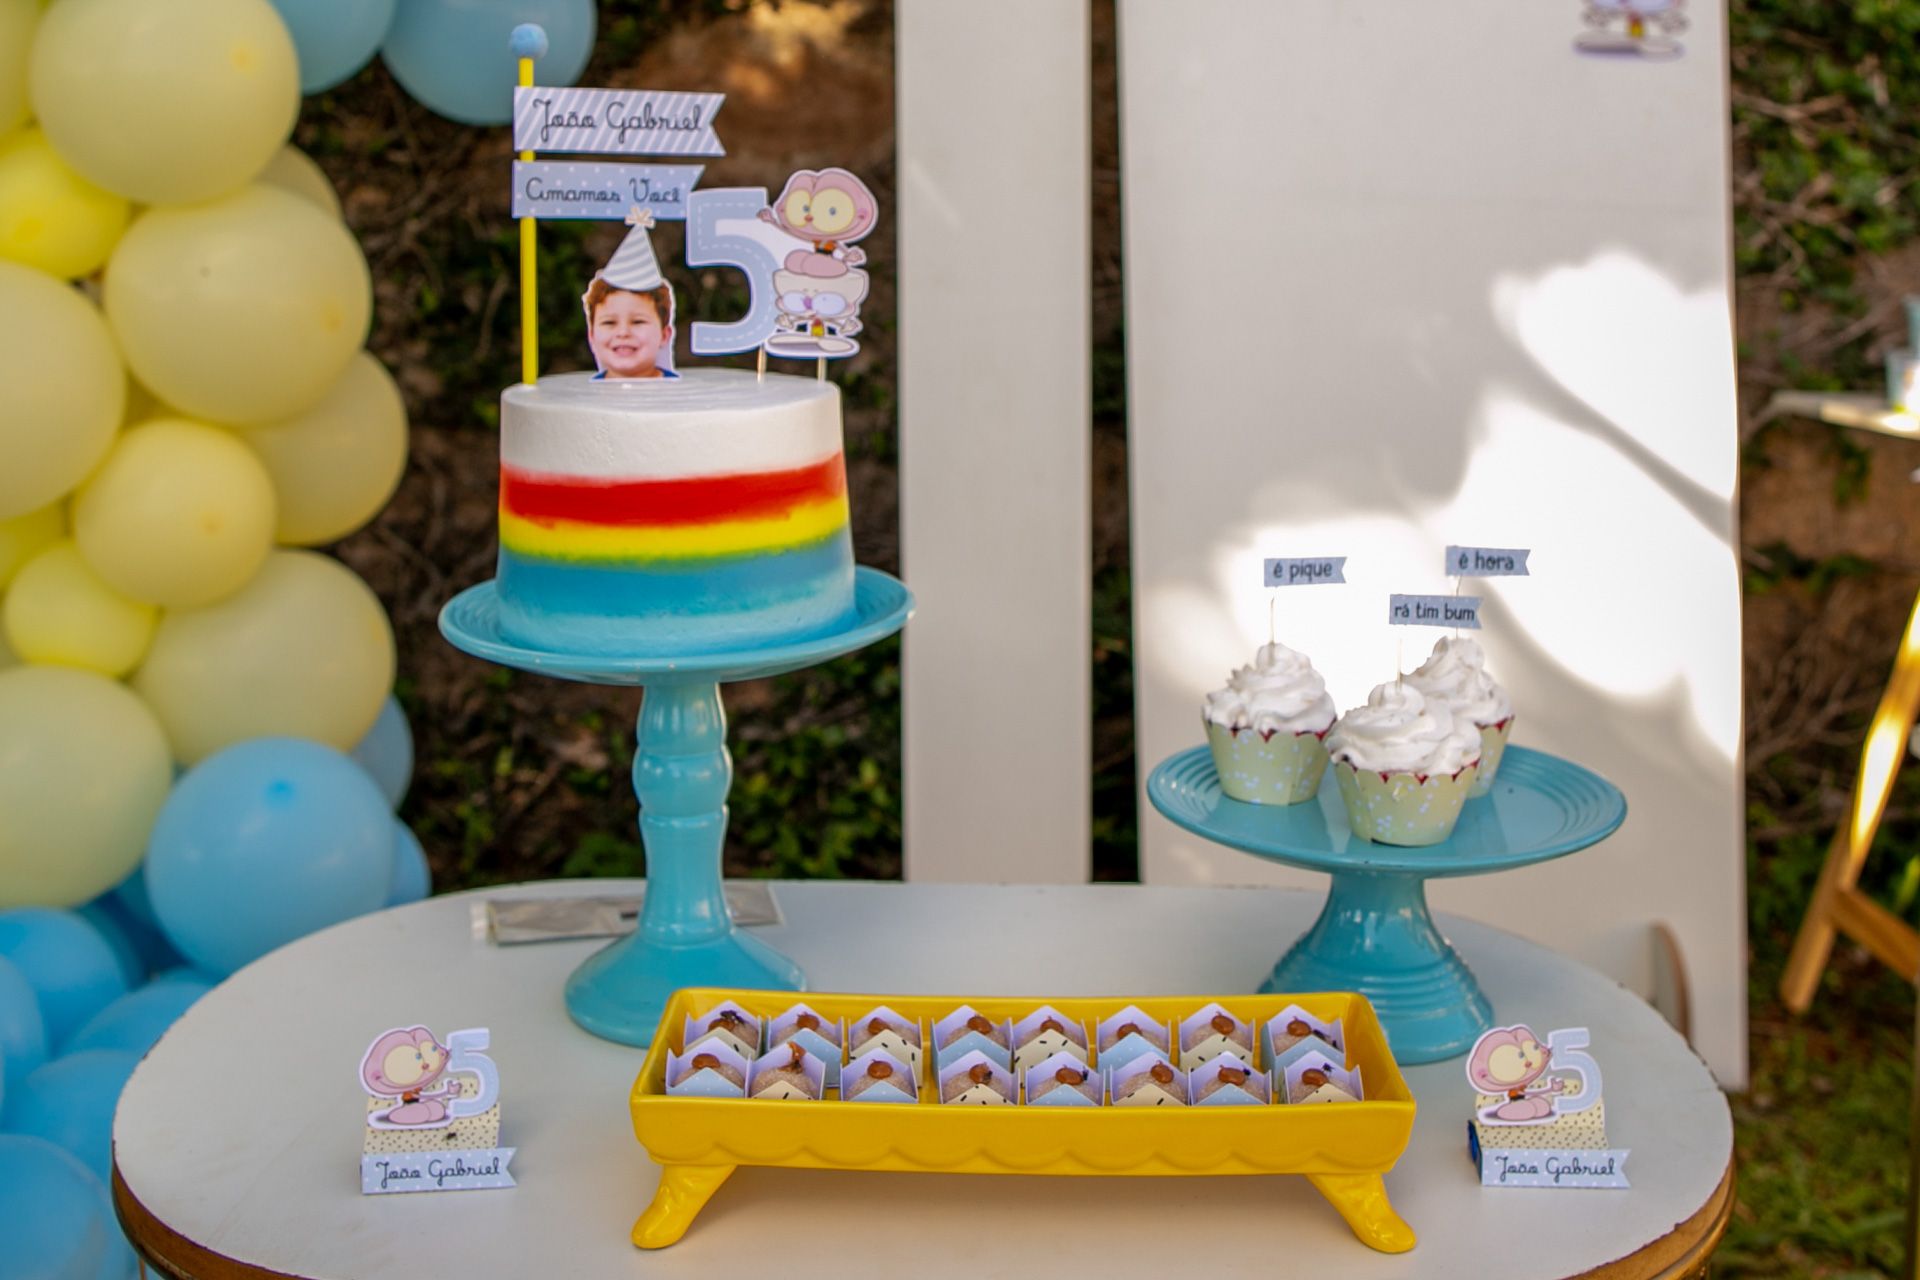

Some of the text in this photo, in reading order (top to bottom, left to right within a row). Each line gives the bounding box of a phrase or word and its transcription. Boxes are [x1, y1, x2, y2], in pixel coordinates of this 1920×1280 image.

[532, 98, 702, 144] João Gabriel
[629, 178, 681, 203] Você
[686, 187, 780, 354] 5
[1273, 560, 1333, 582] é pique
[1458, 551, 1515, 571] é hora
[1394, 603, 1475, 621] rá tim bum
[447, 1027, 500, 1118] 5
[1548, 1027, 1603, 1114] 5
[375, 1157, 500, 1189] João Gabriel
[1495, 1156, 1616, 1183] João Gabriel
